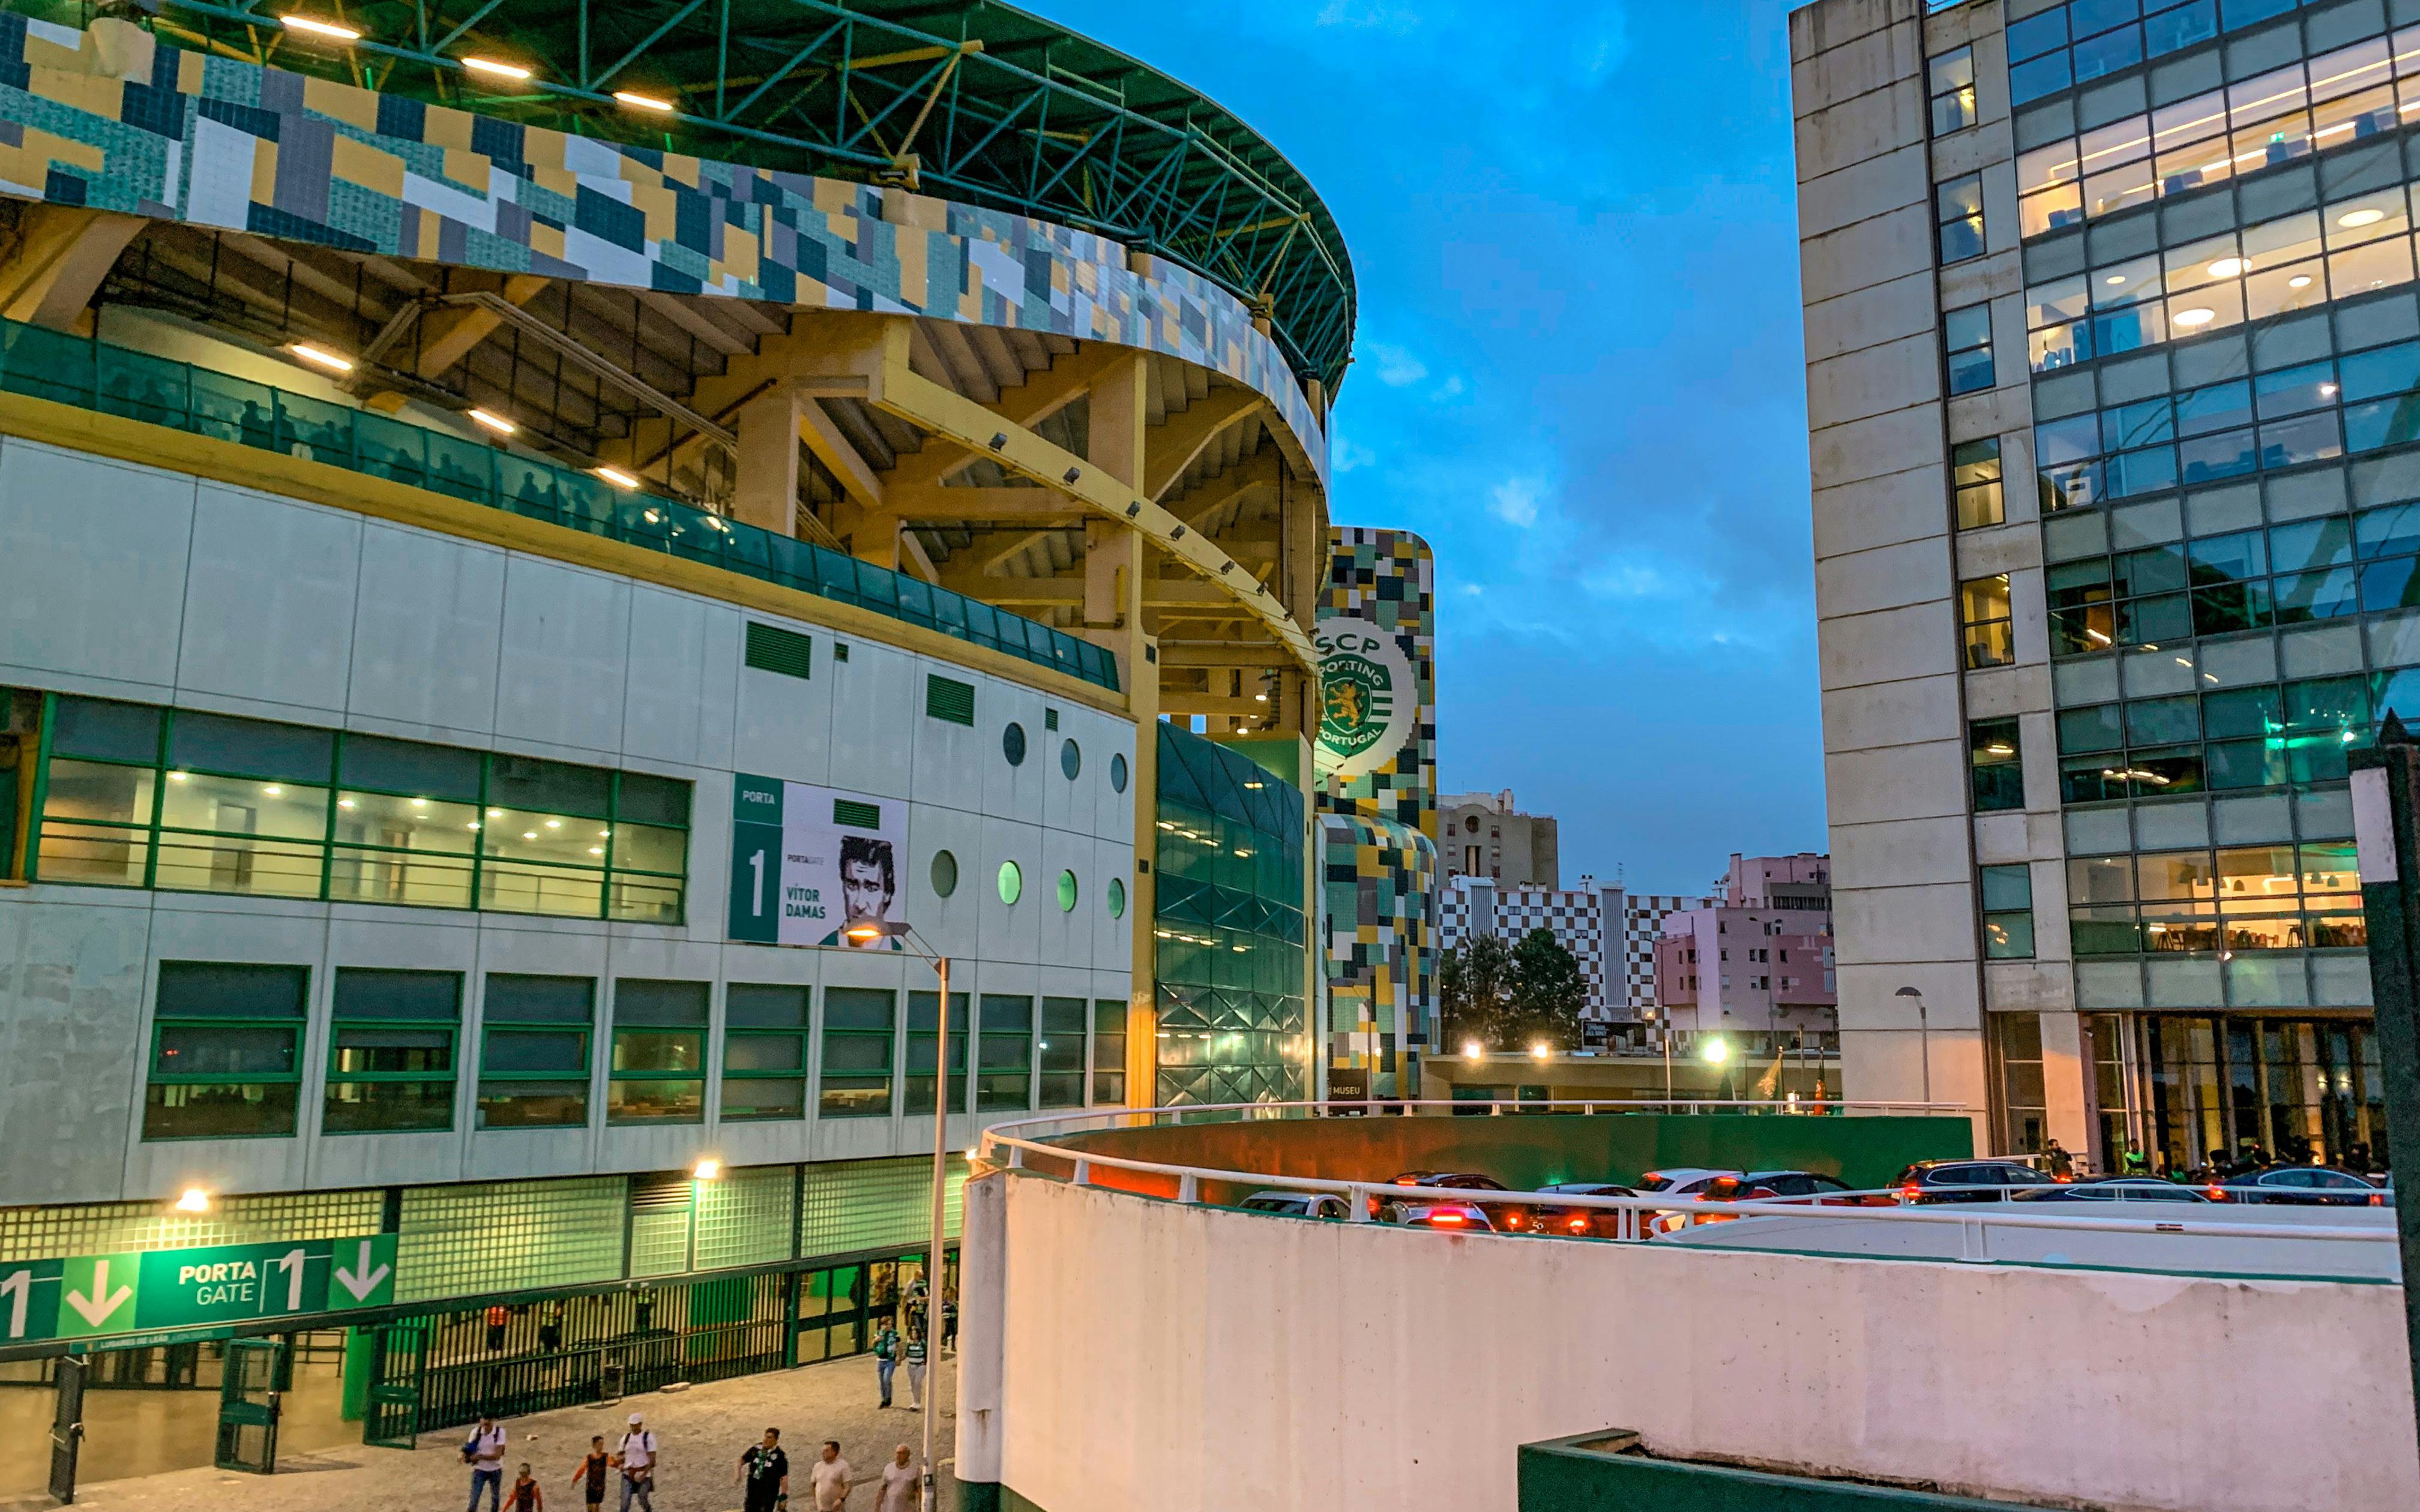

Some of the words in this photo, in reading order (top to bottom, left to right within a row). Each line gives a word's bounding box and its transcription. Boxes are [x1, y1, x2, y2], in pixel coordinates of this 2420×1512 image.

[1315, 634, 1380, 654] SCP
[742, 790, 775, 805] PORTA
[749, 849, 765, 917] 1
[786, 883, 820, 902] VÍTOR
[786, 904, 826, 919] DAMAS
[179, 1261, 257, 1285] PORTA
[278, 1249, 306, 1311] 1
[0, 1269, 31, 1338] 1
[196, 1282, 254, 1306] GATE
